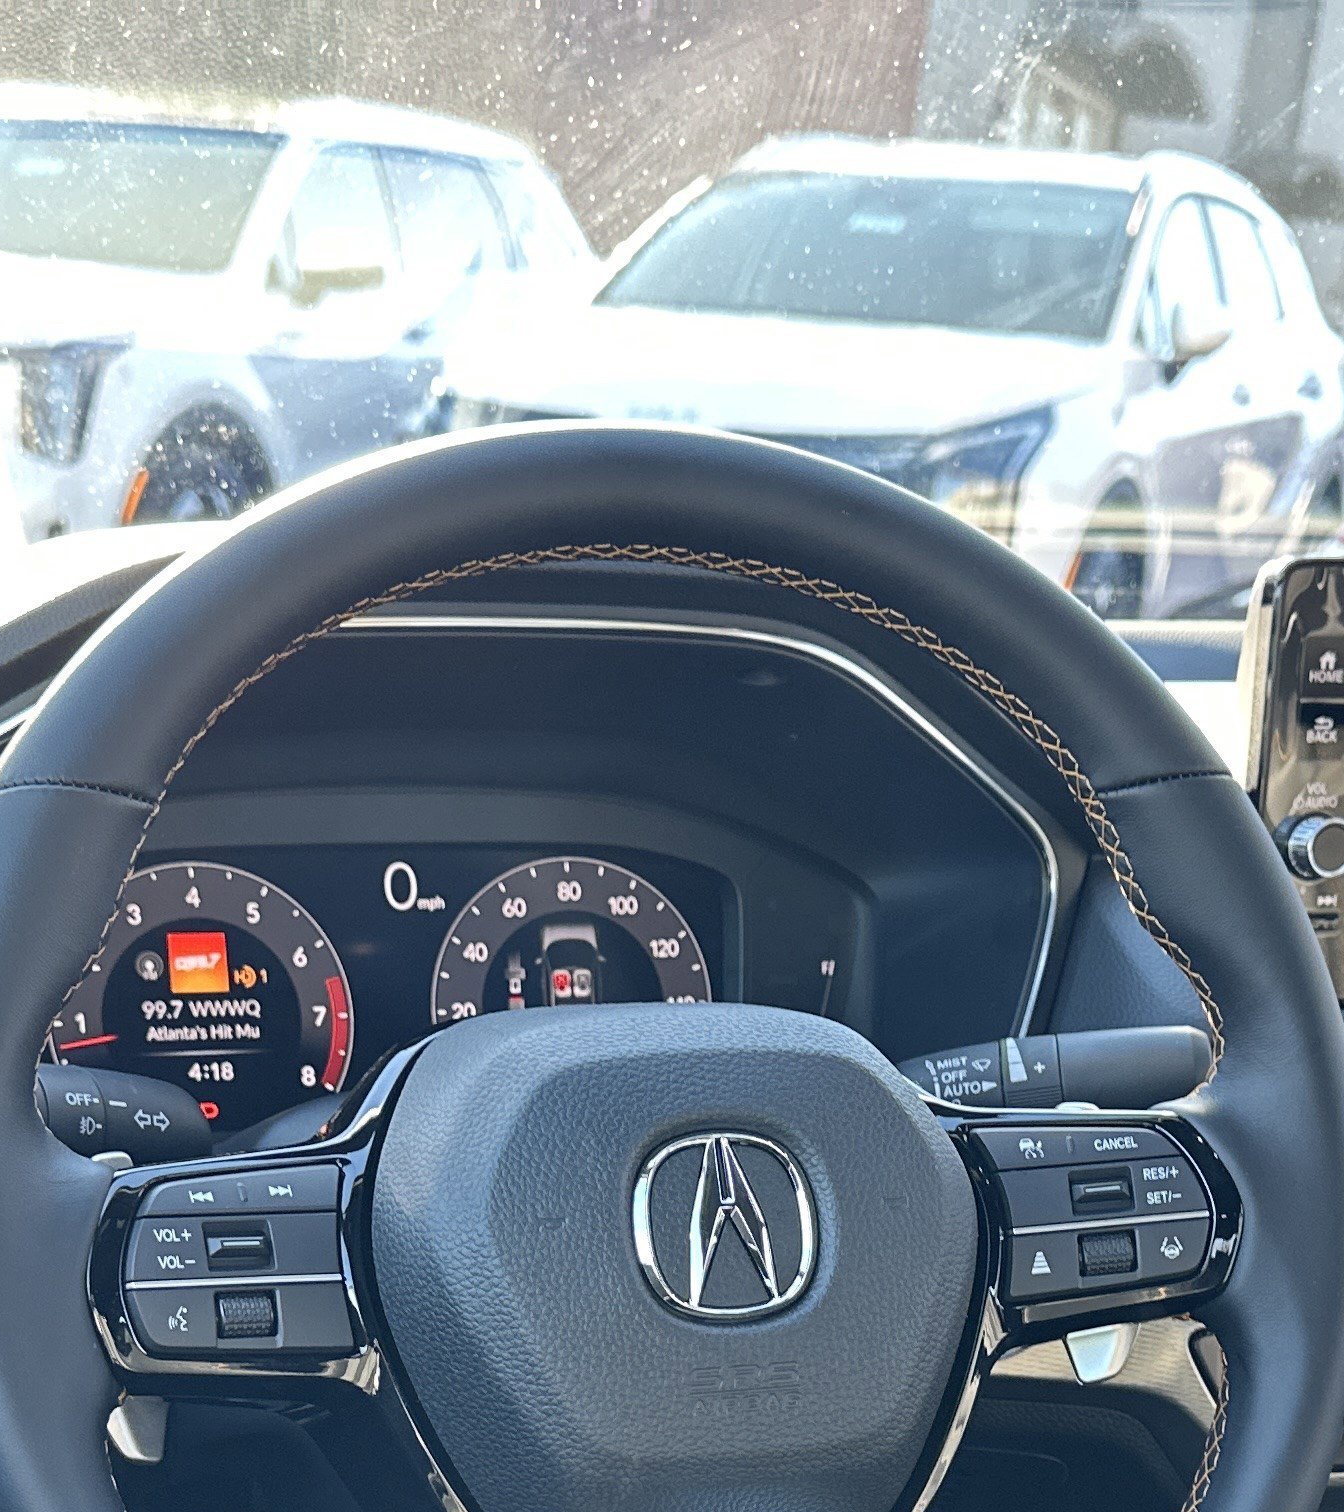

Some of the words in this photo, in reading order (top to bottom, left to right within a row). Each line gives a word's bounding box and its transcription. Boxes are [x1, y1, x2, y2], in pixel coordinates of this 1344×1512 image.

[1309, 668, 1344, 684] HOME
[1306, 729, 1338, 745] BACK
[185, 887, 201, 908] 4
[556, 881, 582, 902] 80
[126, 903, 142, 926] 3
[246, 901, 261, 924] 5
[502, 898, 527, 919] 60
[608, 895, 639, 916] 100
[292, 946, 308, 969] 6
[462, 942, 489, 963] 40
[649, 938, 680, 959] 120
[141, 999, 184, 1020] 99.7
[188, 998, 262, 1019] WWWQ
[312, 1006, 328, 1027] 7
[74, 1013, 87, 1034] 1
[145, 1025, 208, 1042] Atlanta's
[209, 1024, 233, 1040] Hit
[234, 1022, 261, 1040] Mu
[187, 1061, 235, 1082] 4:18
[937, 1056, 968, 1071] MIST
[300, 1065, 316, 1087] 8
[941, 1070, 968, 1084] OFF
[65, 1092, 93, 1107] OFF
[943, 1082, 981, 1098] AUTO
[1094, 1136, 1138, 1151] CANCEL
[153, 1228, 192, 1243] VOL+
